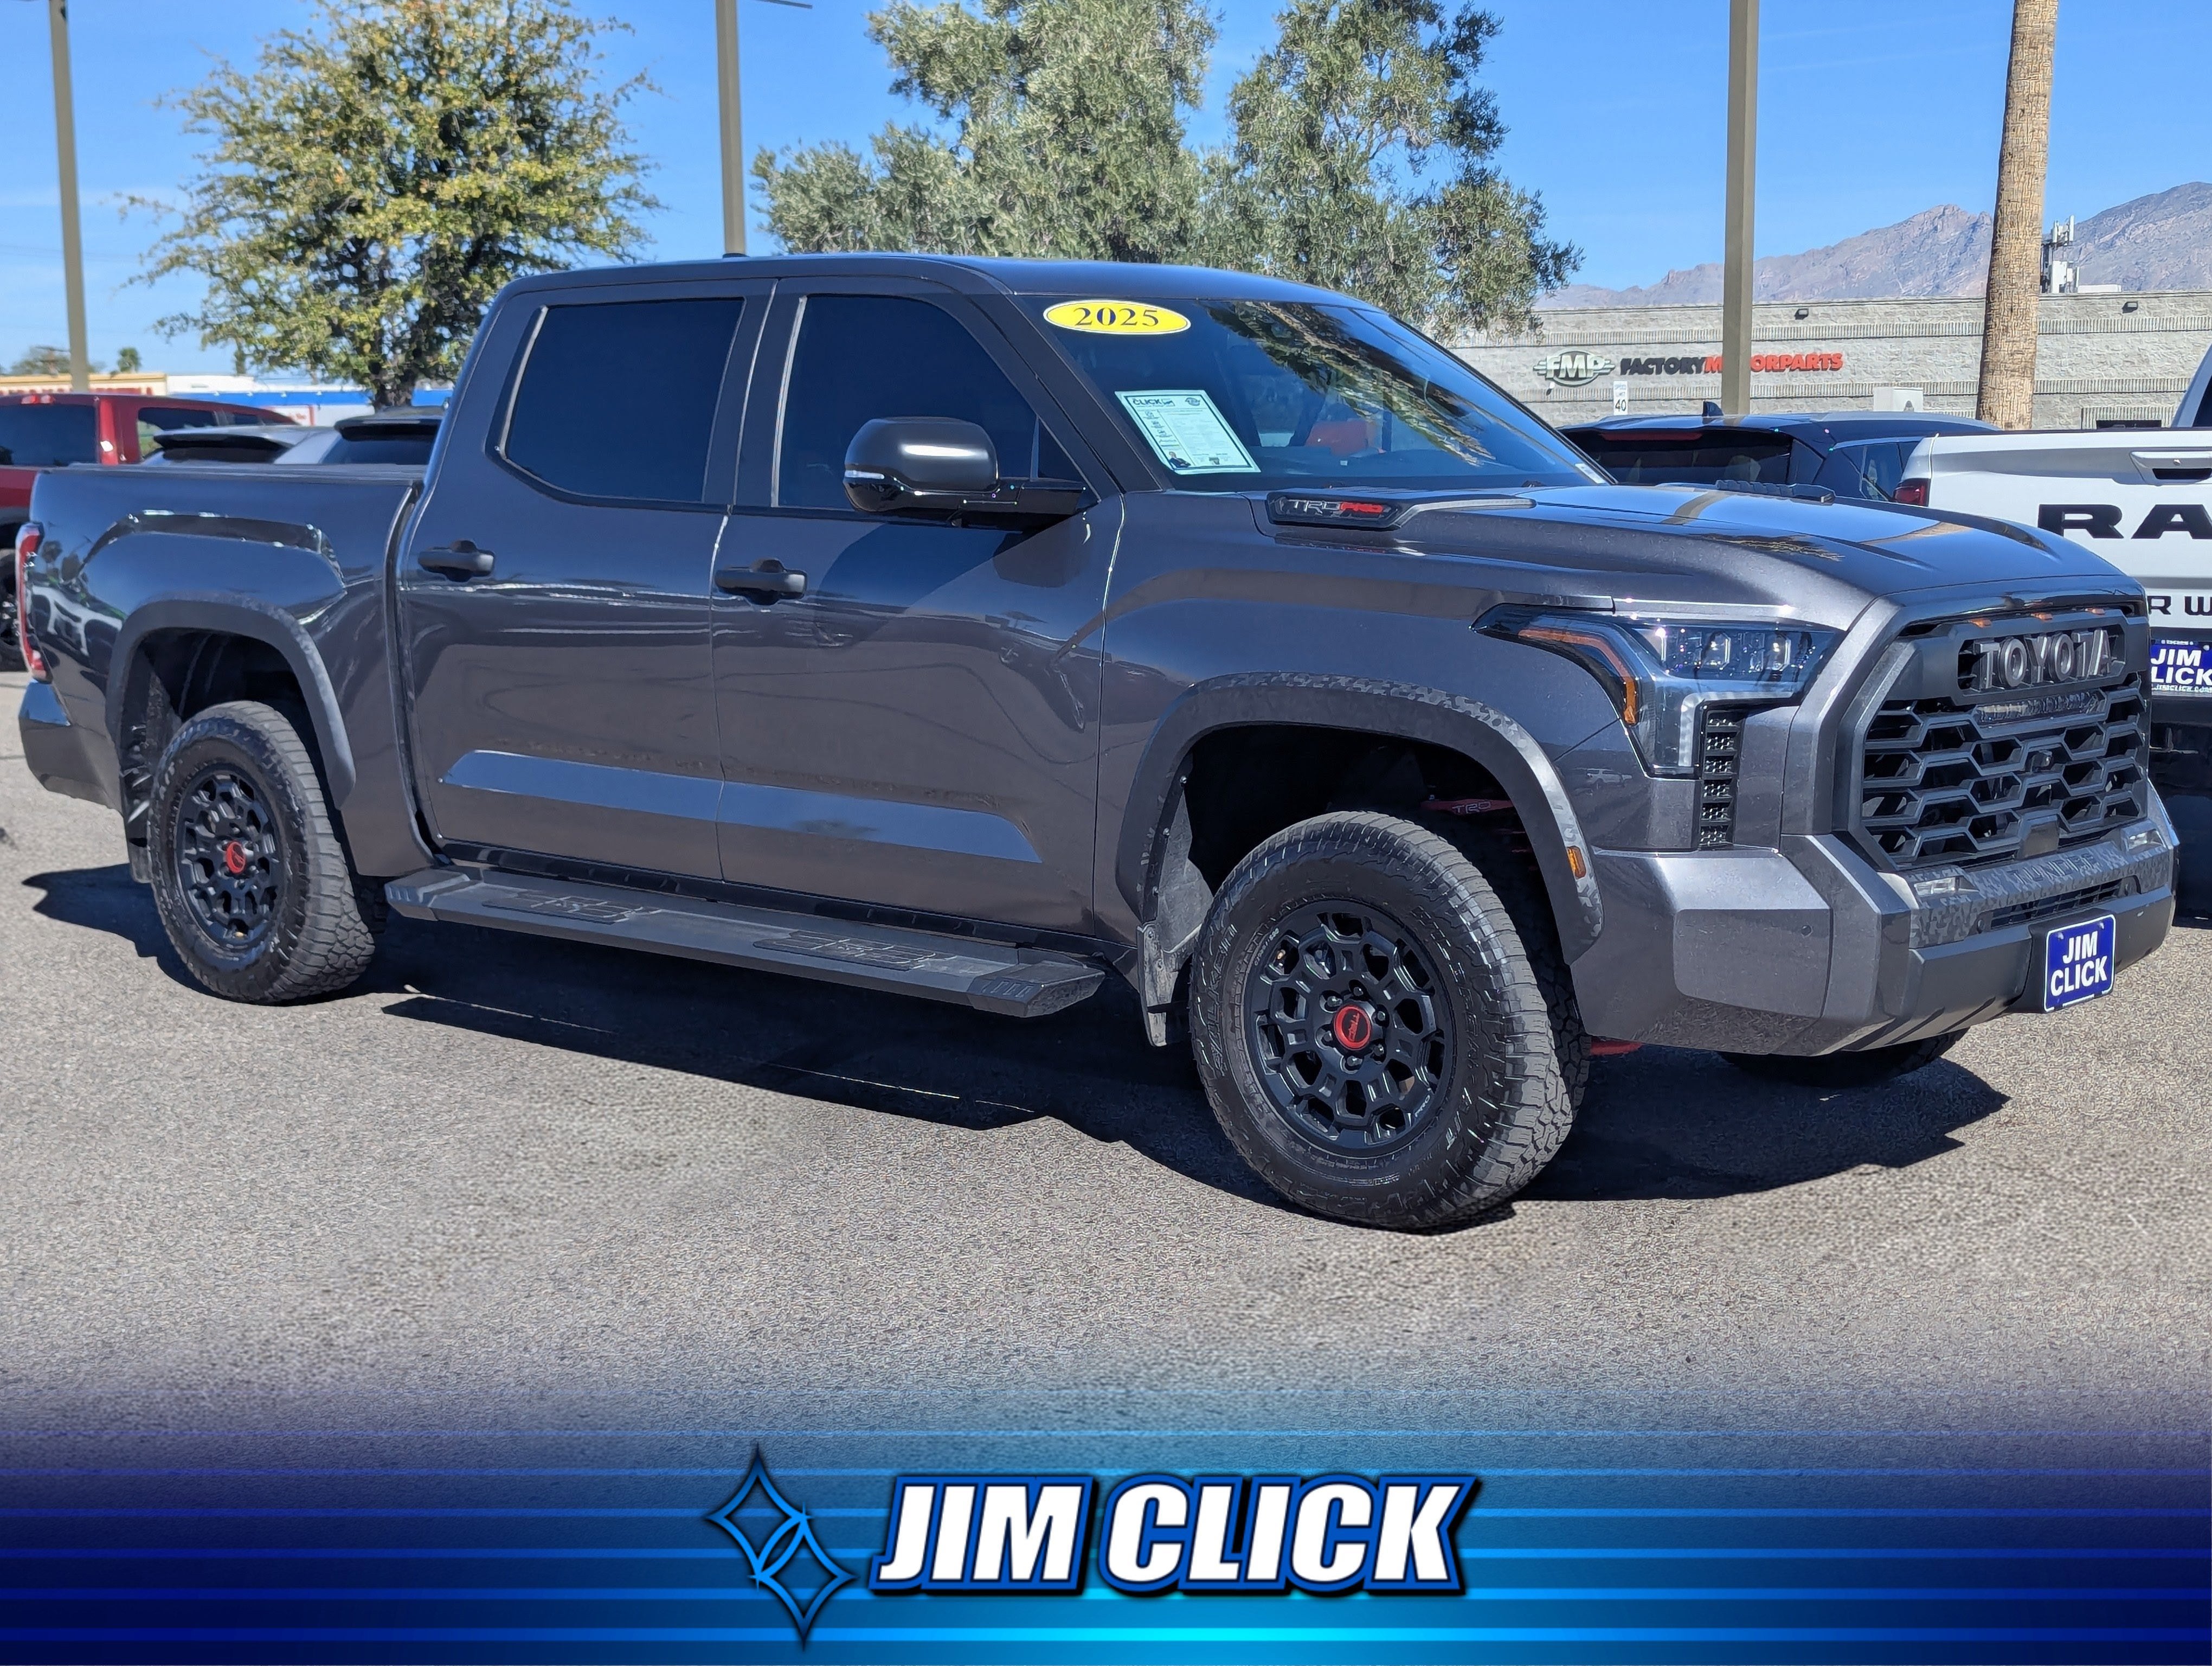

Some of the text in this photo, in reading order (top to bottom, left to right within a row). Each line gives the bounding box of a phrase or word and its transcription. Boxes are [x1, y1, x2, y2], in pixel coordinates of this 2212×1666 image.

[1073, 307, 1159, 326] 2025
[1545, 354, 1605, 379] FMP
[1620, 356, 1706, 376] FACTORY
[1615, 399, 1626, 412] 40
[1973, 629, 2112, 690] TOYOTA
[2150, 648, 2202, 667] JIM
[1452, 801, 1491, 814] TRD
[2062, 931, 2098, 964] JIM
[2050, 956, 2108, 997] CLICK
